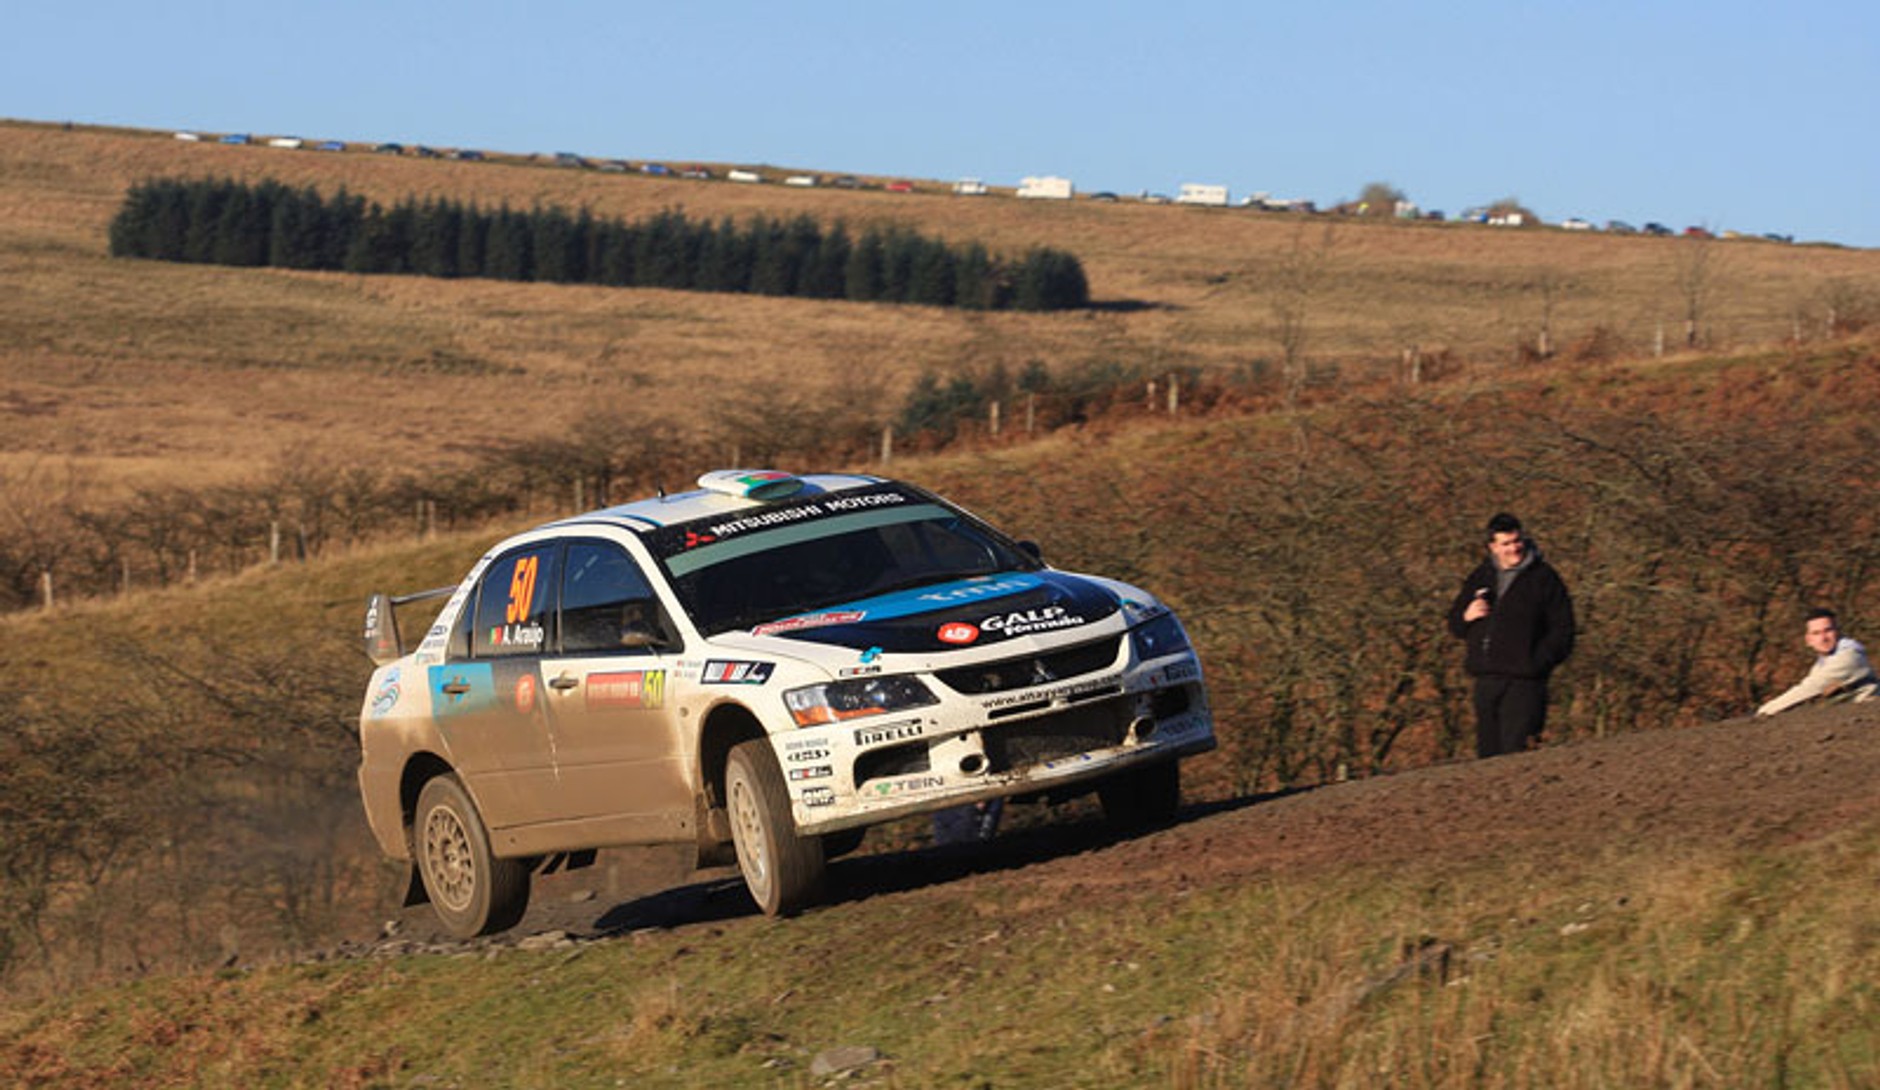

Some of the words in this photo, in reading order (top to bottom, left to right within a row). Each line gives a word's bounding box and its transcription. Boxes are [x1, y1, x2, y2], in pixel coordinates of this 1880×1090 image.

[711, 502, 822, 536] MITSUBISHI
[825, 493, 904, 512] MOTORS
[506, 556, 538, 623] 50
[980, 606, 1065, 631] GALP
[643, 670, 665, 708] 50
[854, 718, 922, 745] PIRELLI
[894, 776, 944, 791] TEIN
